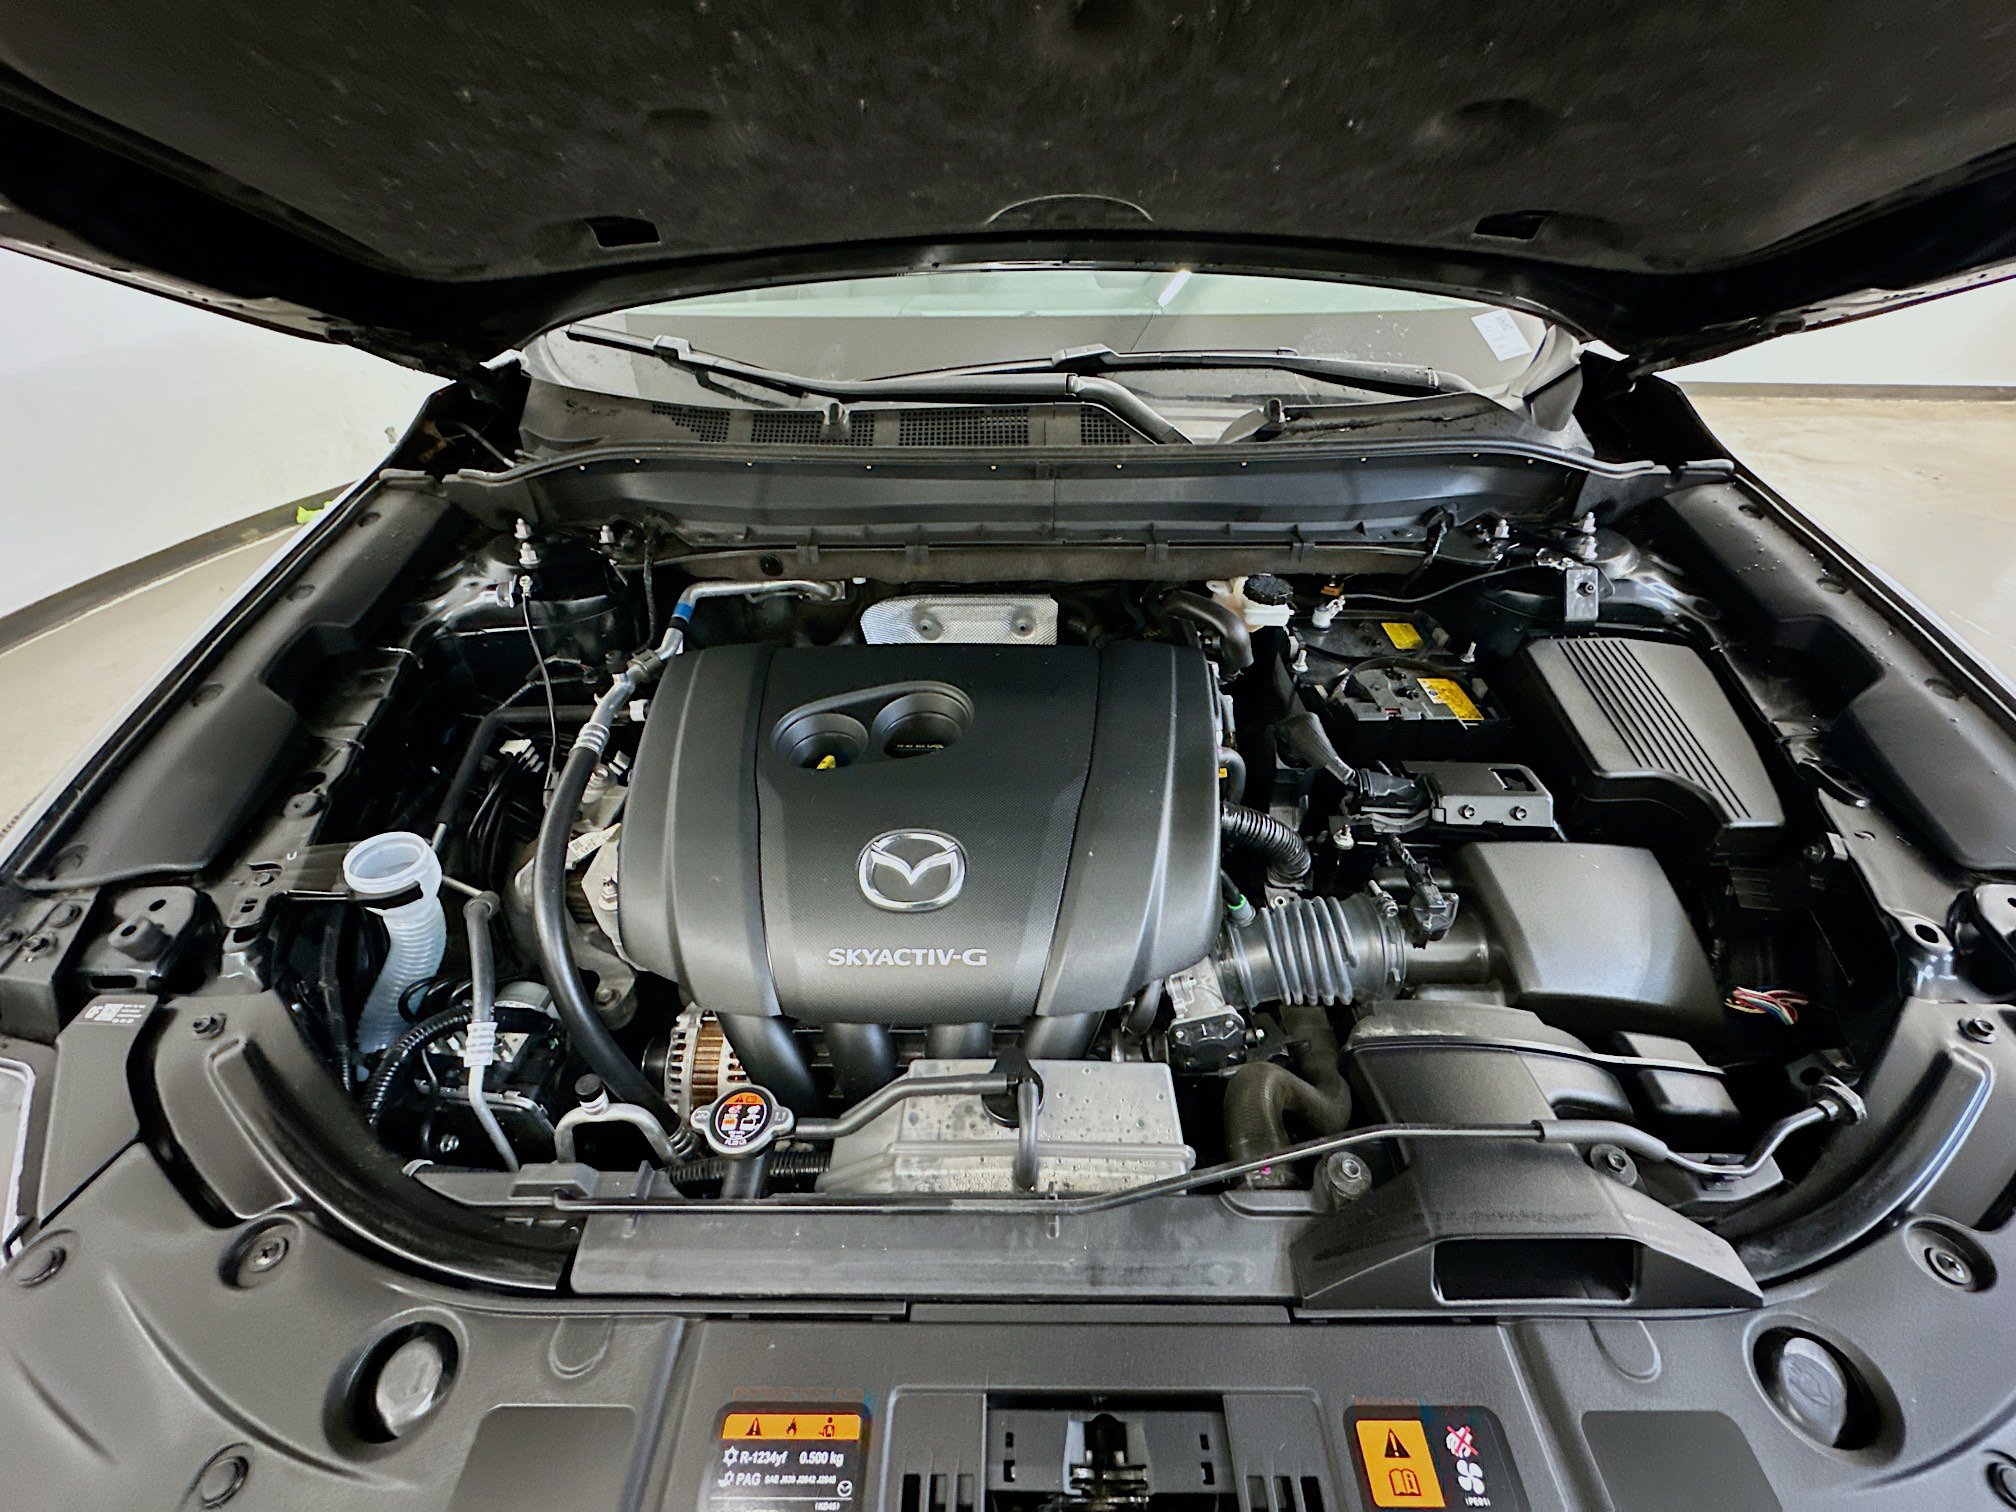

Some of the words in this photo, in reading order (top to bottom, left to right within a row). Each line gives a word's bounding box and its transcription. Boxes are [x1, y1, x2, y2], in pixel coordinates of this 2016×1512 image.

[827, 948, 987, 966] SKYACTIV-G
[739, 1451, 788, 1467] R-1234yf
[799, 1451, 828, 1465] 0.500
[829, 1451, 844, 1467] kg
[736, 1472, 761, 1486] PAG
